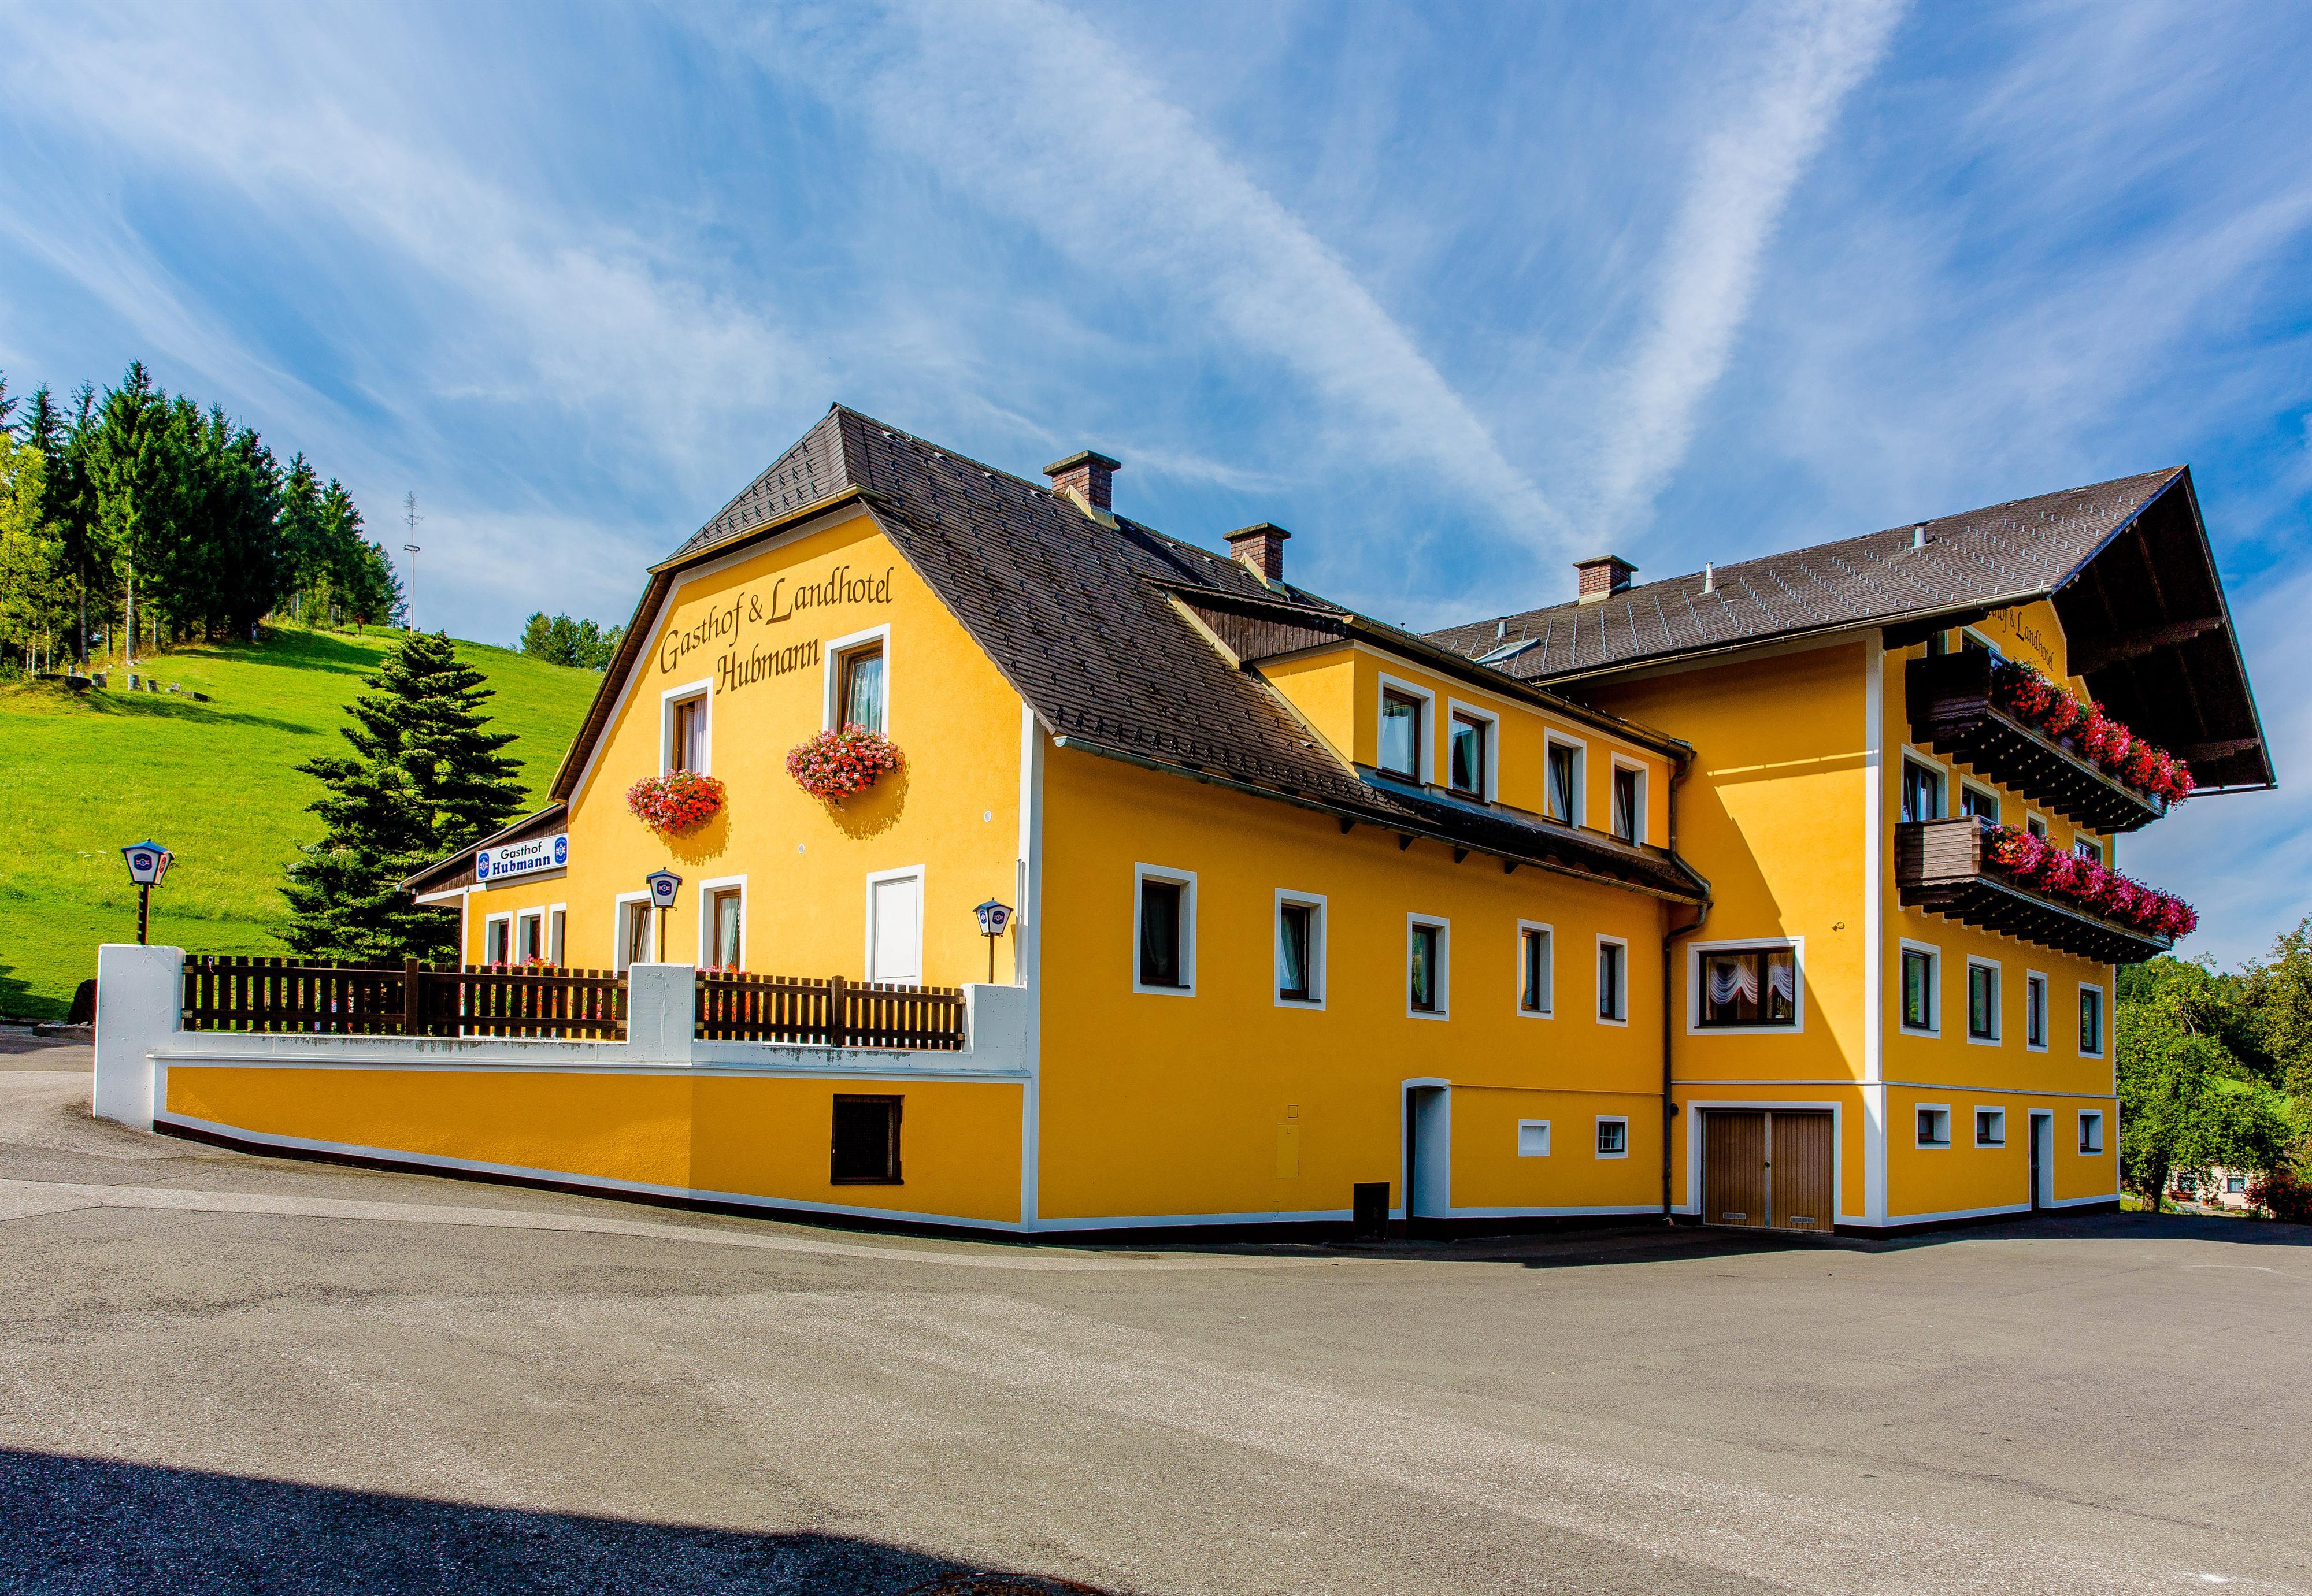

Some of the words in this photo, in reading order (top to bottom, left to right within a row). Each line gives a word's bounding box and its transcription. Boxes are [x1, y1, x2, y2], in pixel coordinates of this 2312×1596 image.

[660, 592, 745, 674] Gasthof
[748, 594, 762, 623] &
[765, 565, 894, 625] Landhotel
[2015, 611, 2054, 671] Landhotel
[716, 638, 820, 695] Hubmann
[492, 855, 551, 875] Hubmann
[501, 841, 542, 859] Gasthof
